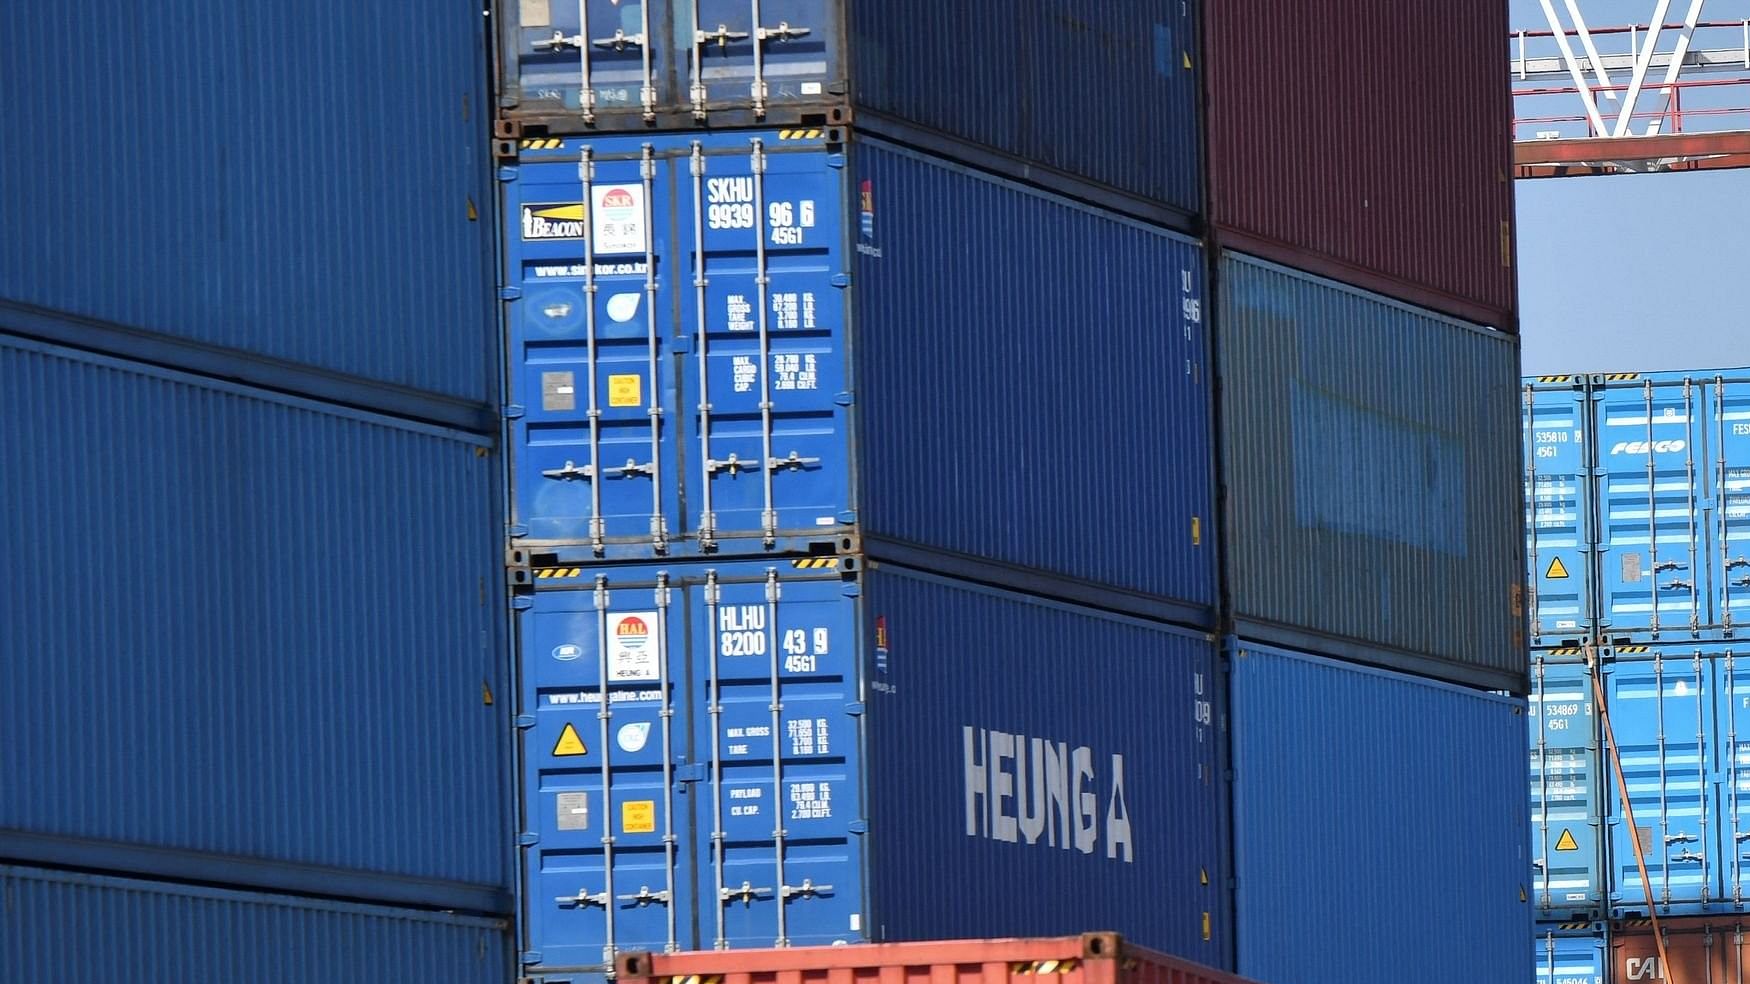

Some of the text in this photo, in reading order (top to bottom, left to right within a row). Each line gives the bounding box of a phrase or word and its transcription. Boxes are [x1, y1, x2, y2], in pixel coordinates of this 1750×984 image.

[707, 177, 753, 203] SKHU
[708, 201, 814, 229] 9939 96 6
[532, 217, 584, 237] BEACON
[771, 227, 803, 244] 45G1
[1536, 431, 1568, 443] 535810
[1537, 447, 1557, 458] 45G1
[1611, 439, 1686, 455] FESCO
[720, 605, 765, 631] HLHU
[620, 624, 646, 634] HAL
[721, 628, 828, 656] 8200 43 9
[784, 655, 816, 672] 45G1
[1547, 704, 1578, 716] 534869
[1548, 719, 1569, 730] 45G1
[963, 726, 1133, 863] HEUNG A
